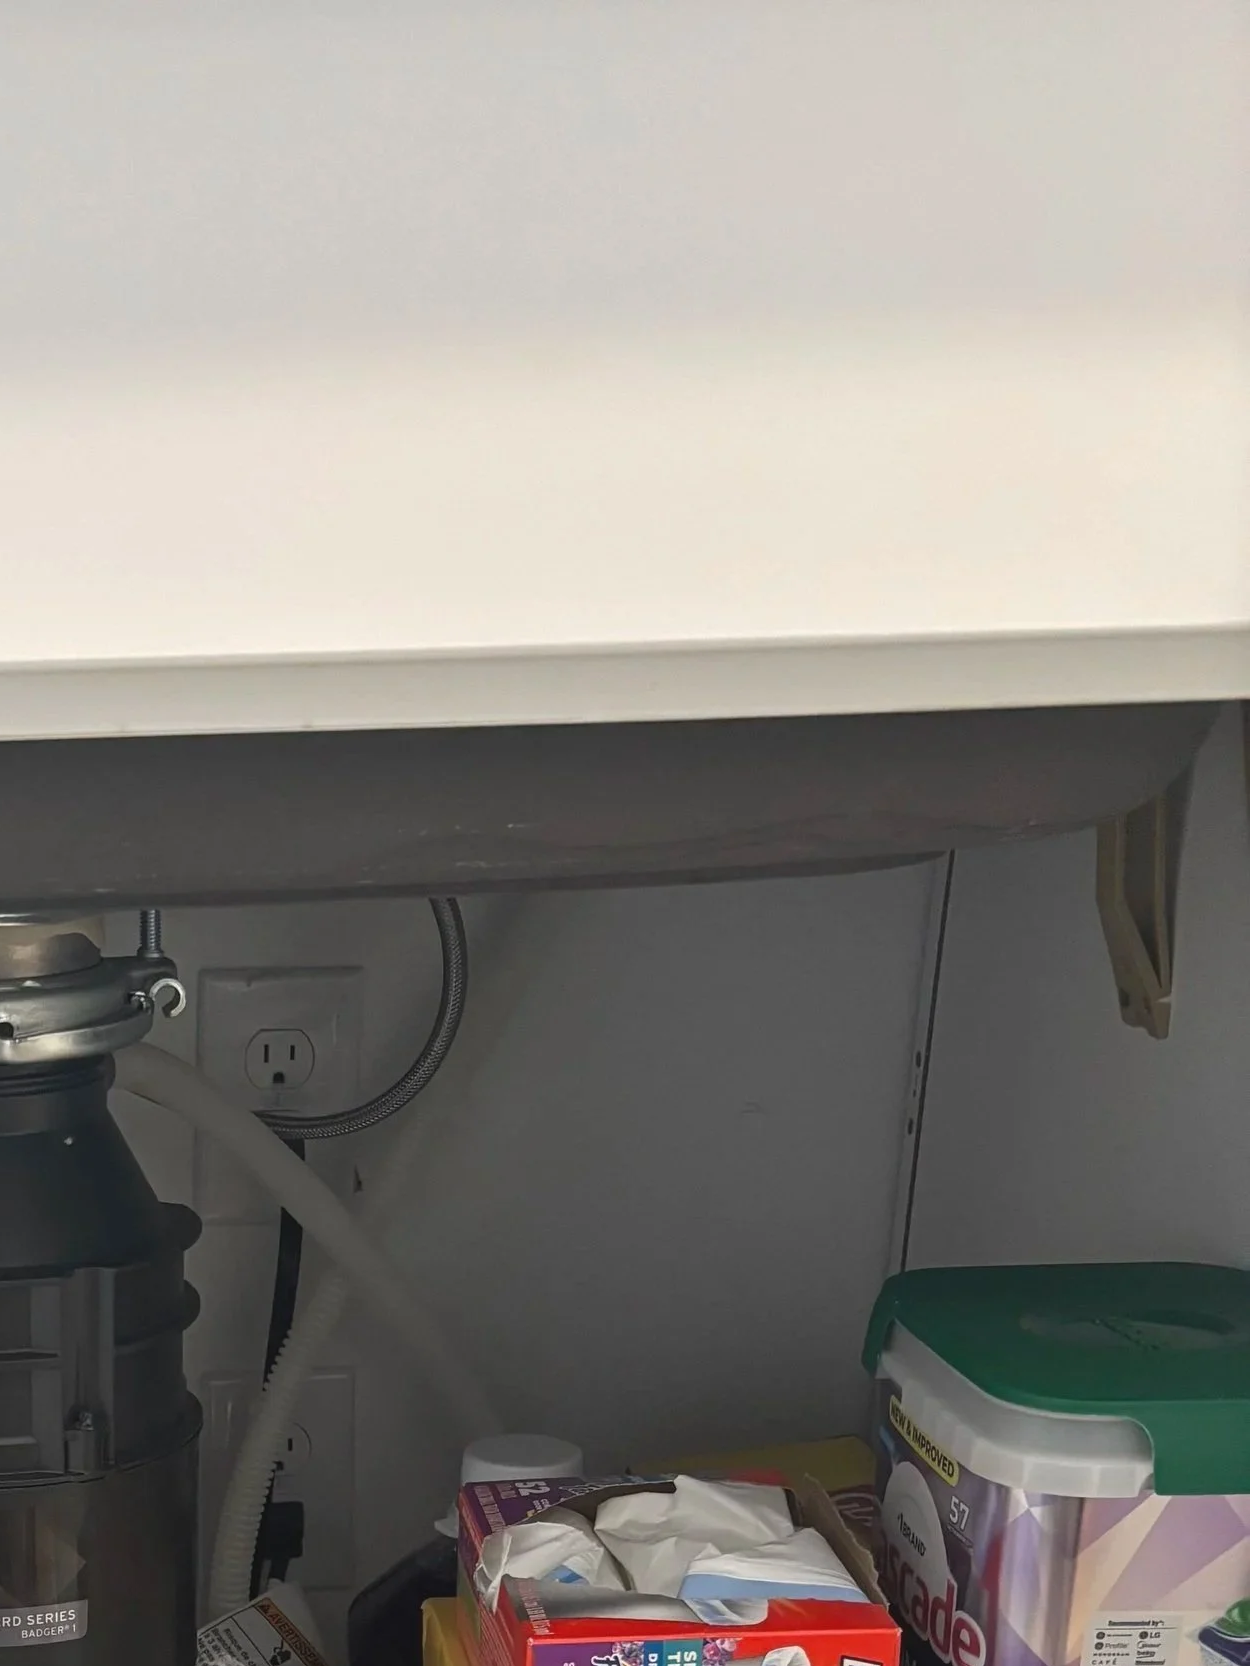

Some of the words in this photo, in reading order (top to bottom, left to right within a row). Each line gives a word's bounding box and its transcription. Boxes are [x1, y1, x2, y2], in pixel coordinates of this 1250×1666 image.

[912, 1425, 955, 1479] IMPROVED
[950, 1496, 970, 1530] 57
[26, 1610, 76, 1626] SERIES
